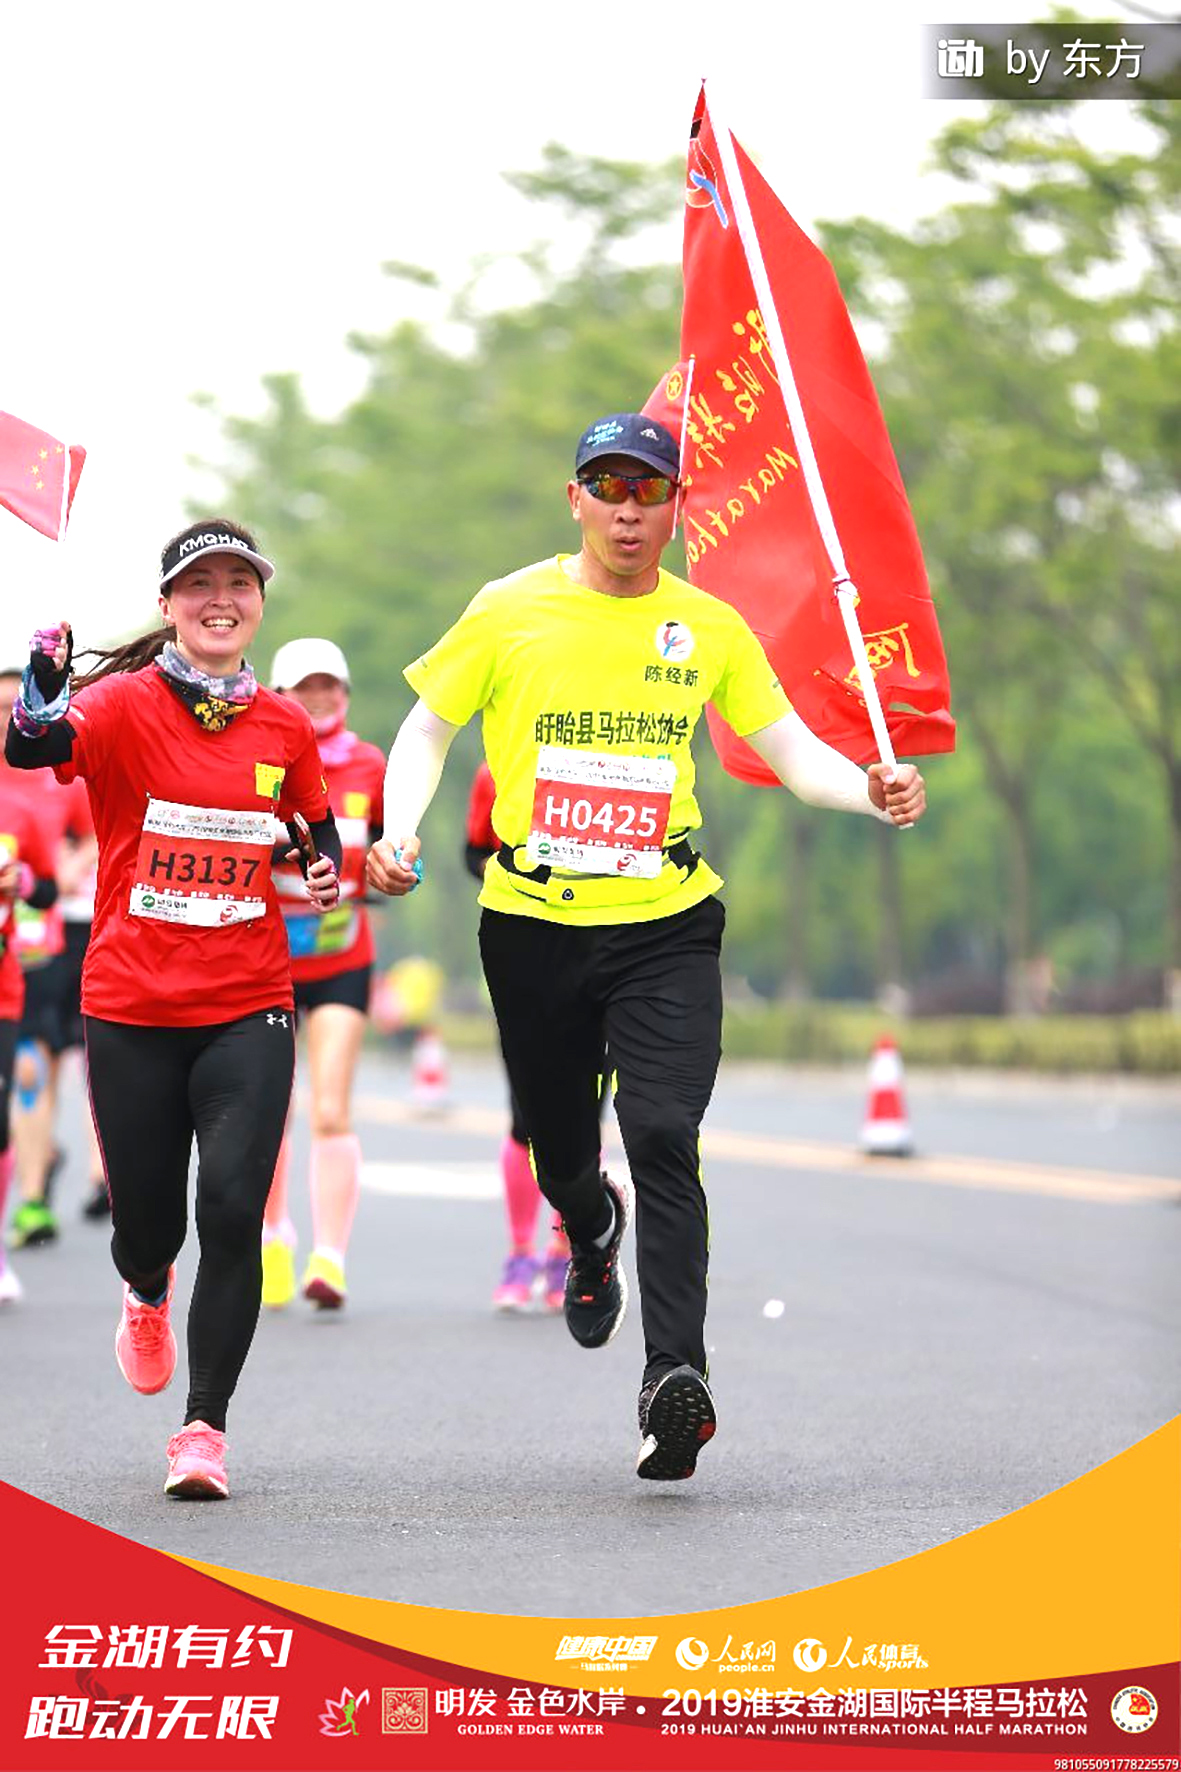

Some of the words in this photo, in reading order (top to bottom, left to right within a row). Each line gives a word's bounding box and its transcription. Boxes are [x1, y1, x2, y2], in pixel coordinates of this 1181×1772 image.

[644, 665, 699, 687] 陈经新
[544, 795, 657, 838] H0425
[149, 849, 261, 888] H3137
